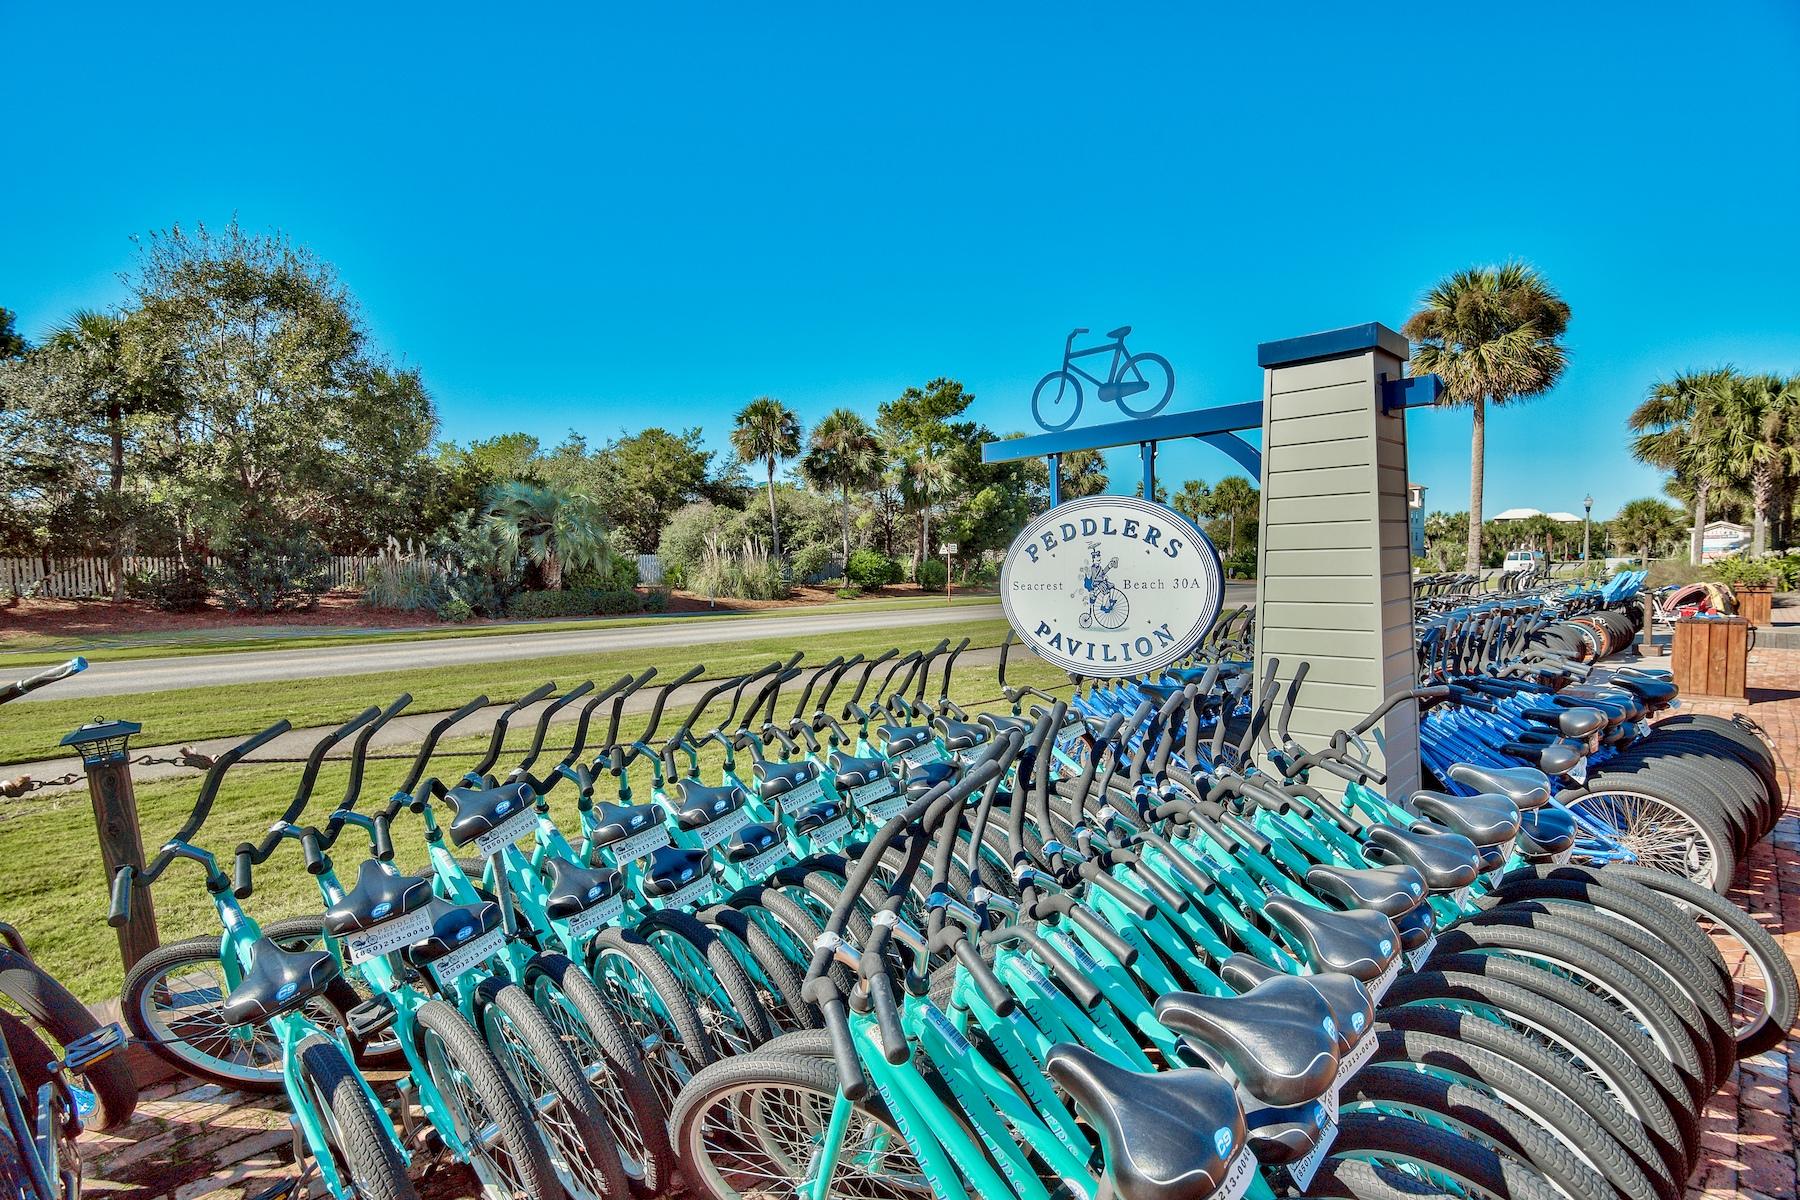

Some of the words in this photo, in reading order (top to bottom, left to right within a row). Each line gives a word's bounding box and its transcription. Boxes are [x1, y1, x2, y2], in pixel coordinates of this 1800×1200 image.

[1024, 517, 1183, 564] PEDDLERS
[1013, 581, 1064, 591] Seacrest
[1123, 579, 1165, 590] Beach
[1172, 578, 1201, 589] 30A
[1034, 620, 1176, 662] PAVILION
[483, 818, 537, 852] (850)213-0040
[355, 925, 430, 959] (850)213-0040
[377, 913, 427, 935] PEDDLERS
[441, 938, 502, 978] (850)213-0040
[1337, 1036, 1376, 1078] 50)213-0040
[879, 1084, 947, 1200] PEDDLE
[1217, 1130, 1232, 1156] C9
[1217, 1147, 1251, 1200] 213-0040
